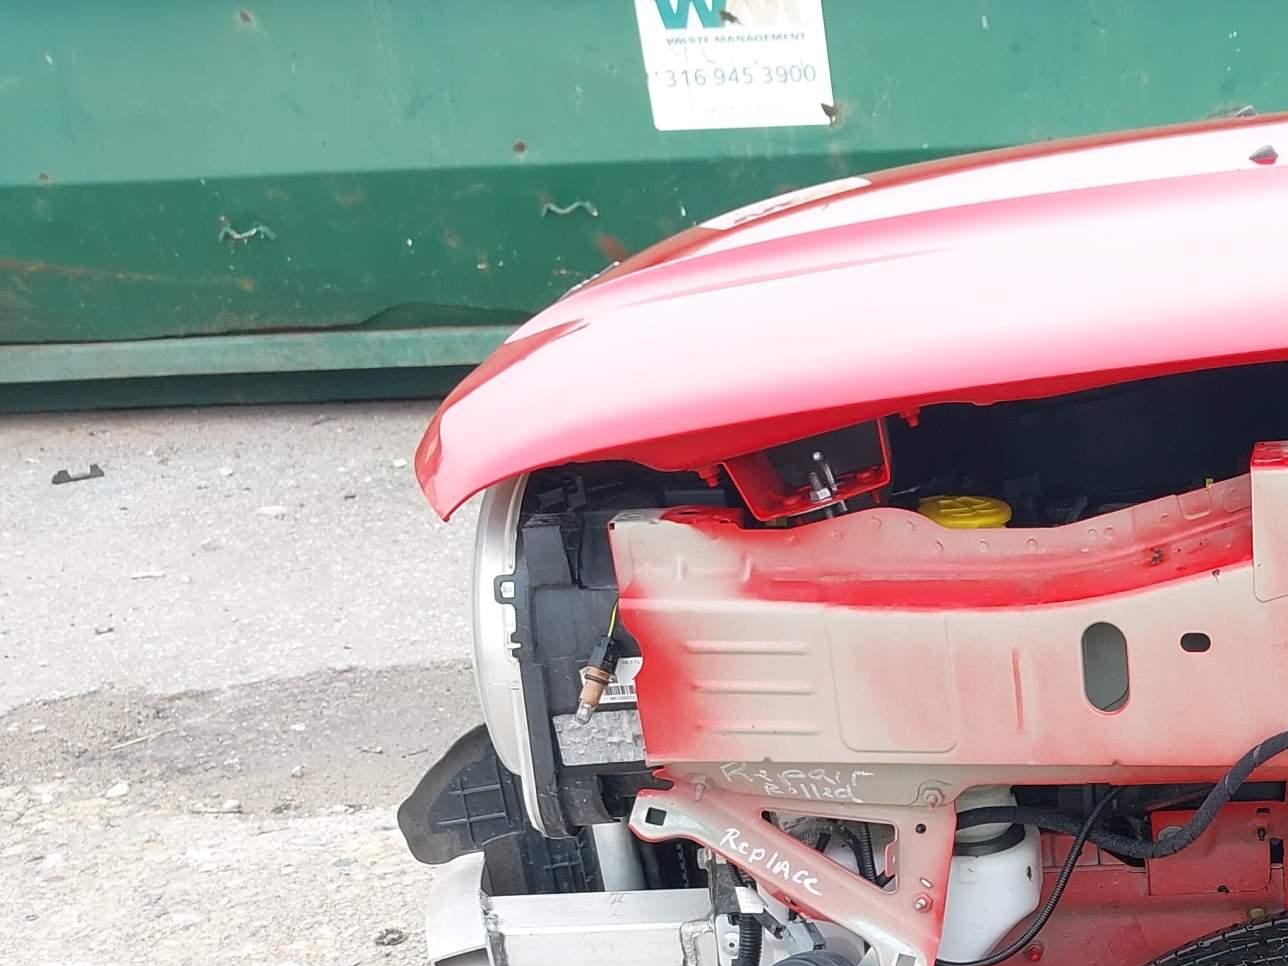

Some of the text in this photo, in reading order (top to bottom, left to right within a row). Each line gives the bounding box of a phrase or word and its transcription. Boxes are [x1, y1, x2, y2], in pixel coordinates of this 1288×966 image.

[666, 33, 806, 46] WASTE MANAGEMENT
[666, 64, 816, 88] 316 945 3900
